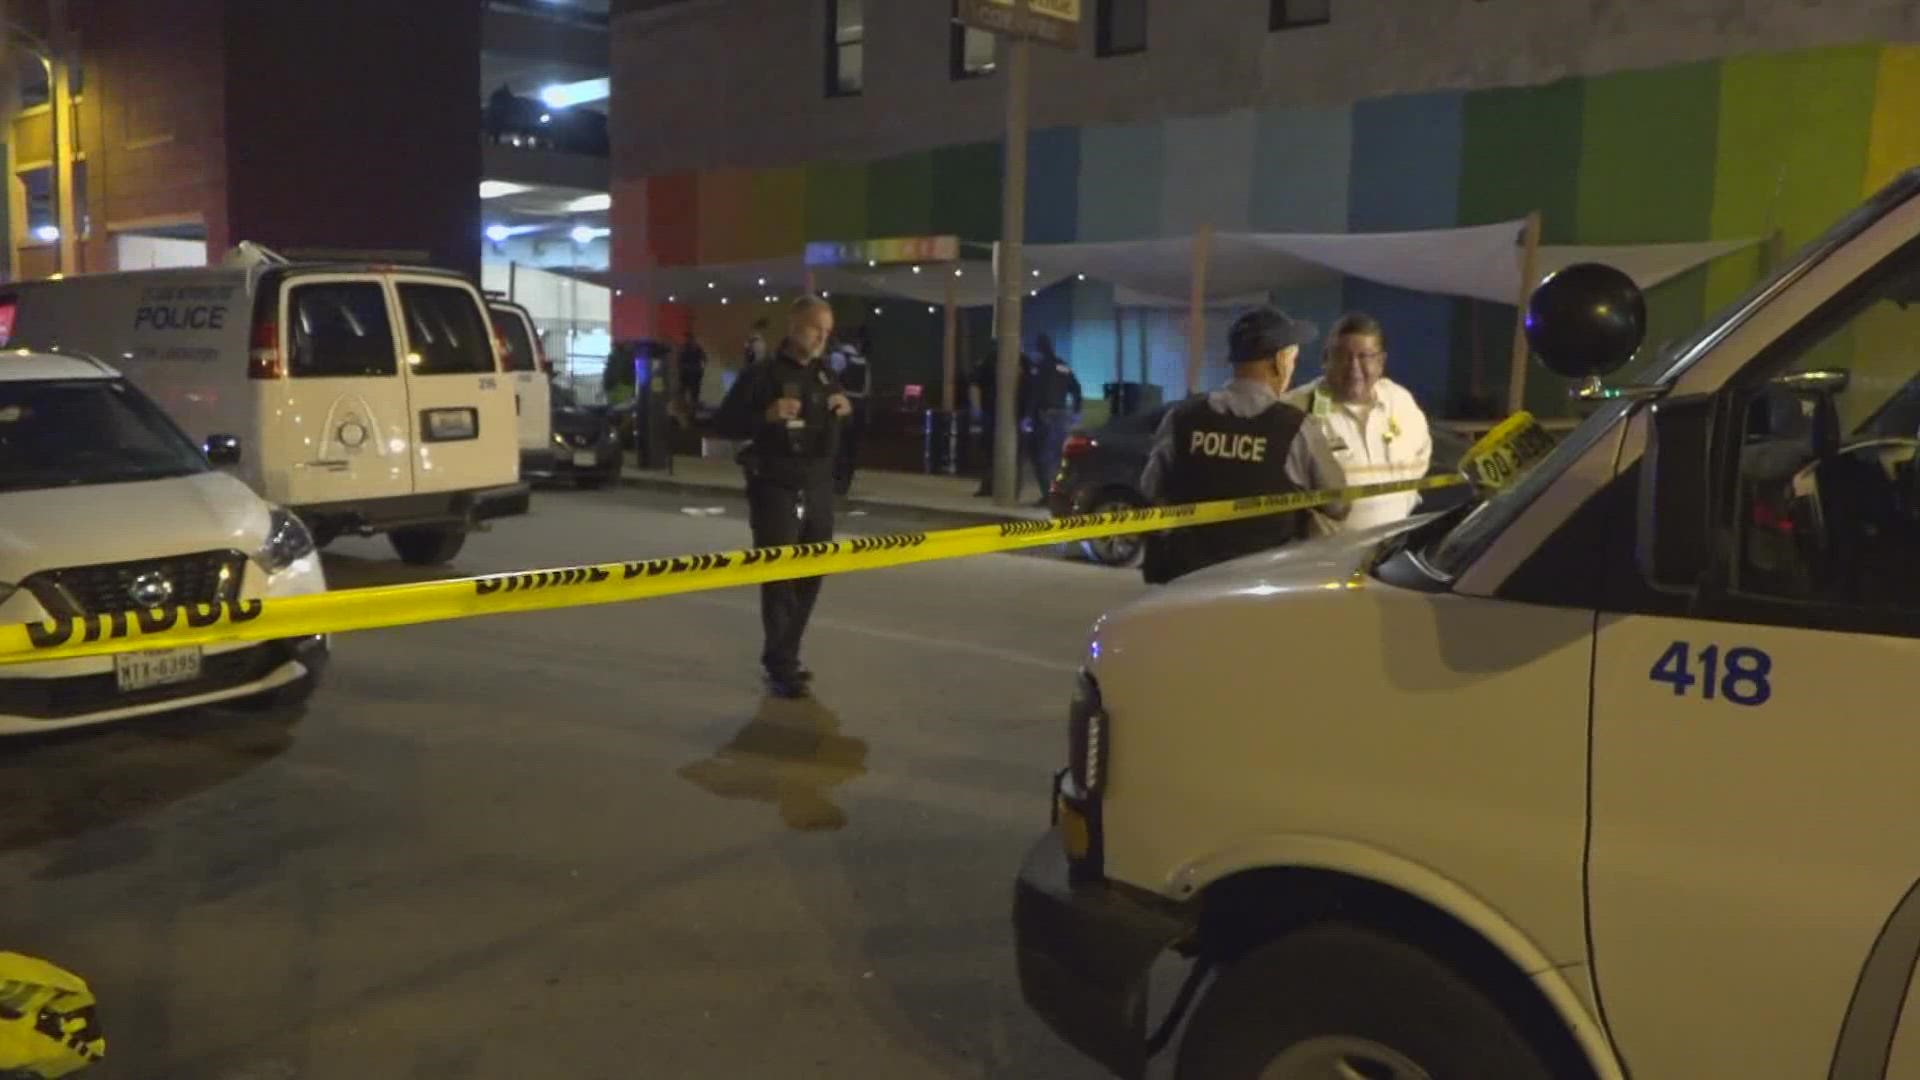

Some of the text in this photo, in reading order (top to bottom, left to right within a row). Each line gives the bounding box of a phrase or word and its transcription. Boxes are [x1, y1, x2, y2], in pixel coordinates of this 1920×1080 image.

[134, 306, 228, 331] POLICE
[1190, 431, 1267, 461] POLICE
[1650, 640, 1772, 706] 418
